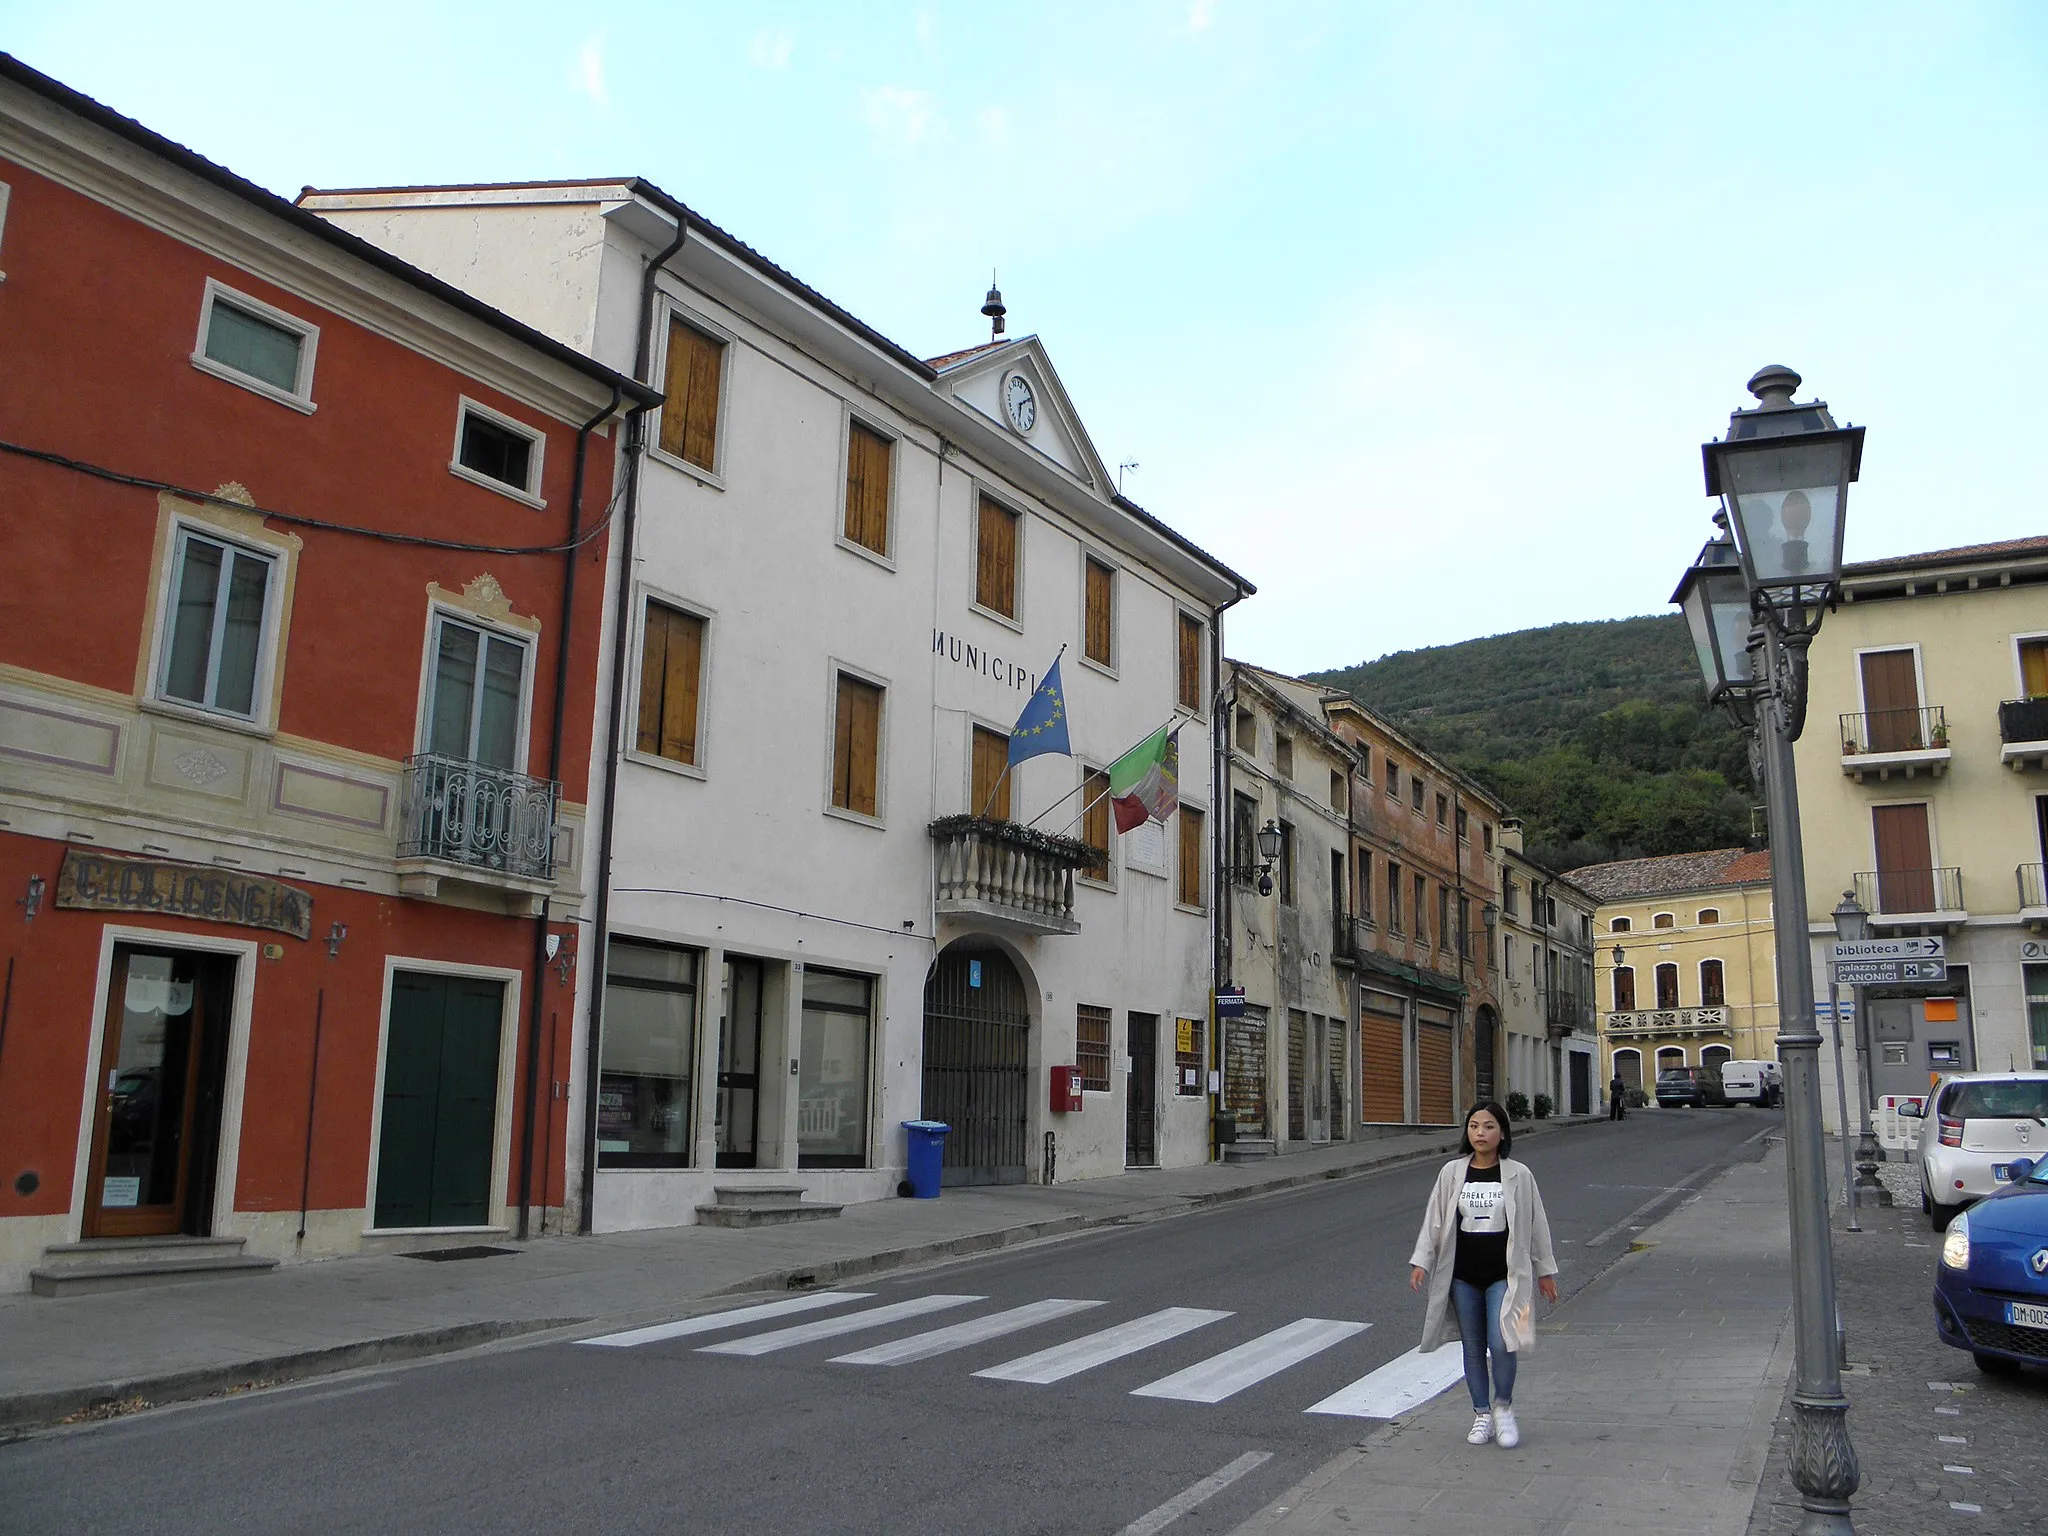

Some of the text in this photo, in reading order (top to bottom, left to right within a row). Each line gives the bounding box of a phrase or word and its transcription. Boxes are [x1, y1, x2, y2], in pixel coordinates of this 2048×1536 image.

[1835, 944, 1899, 956] biblioteca
[1838, 961, 1896, 973] palazzo dei
[1838, 972, 1897, 981] CANONICI
[1461, 1191, 1502, 1200] BREAK THE
[1469, 1199, 1494, 1208] RULES
